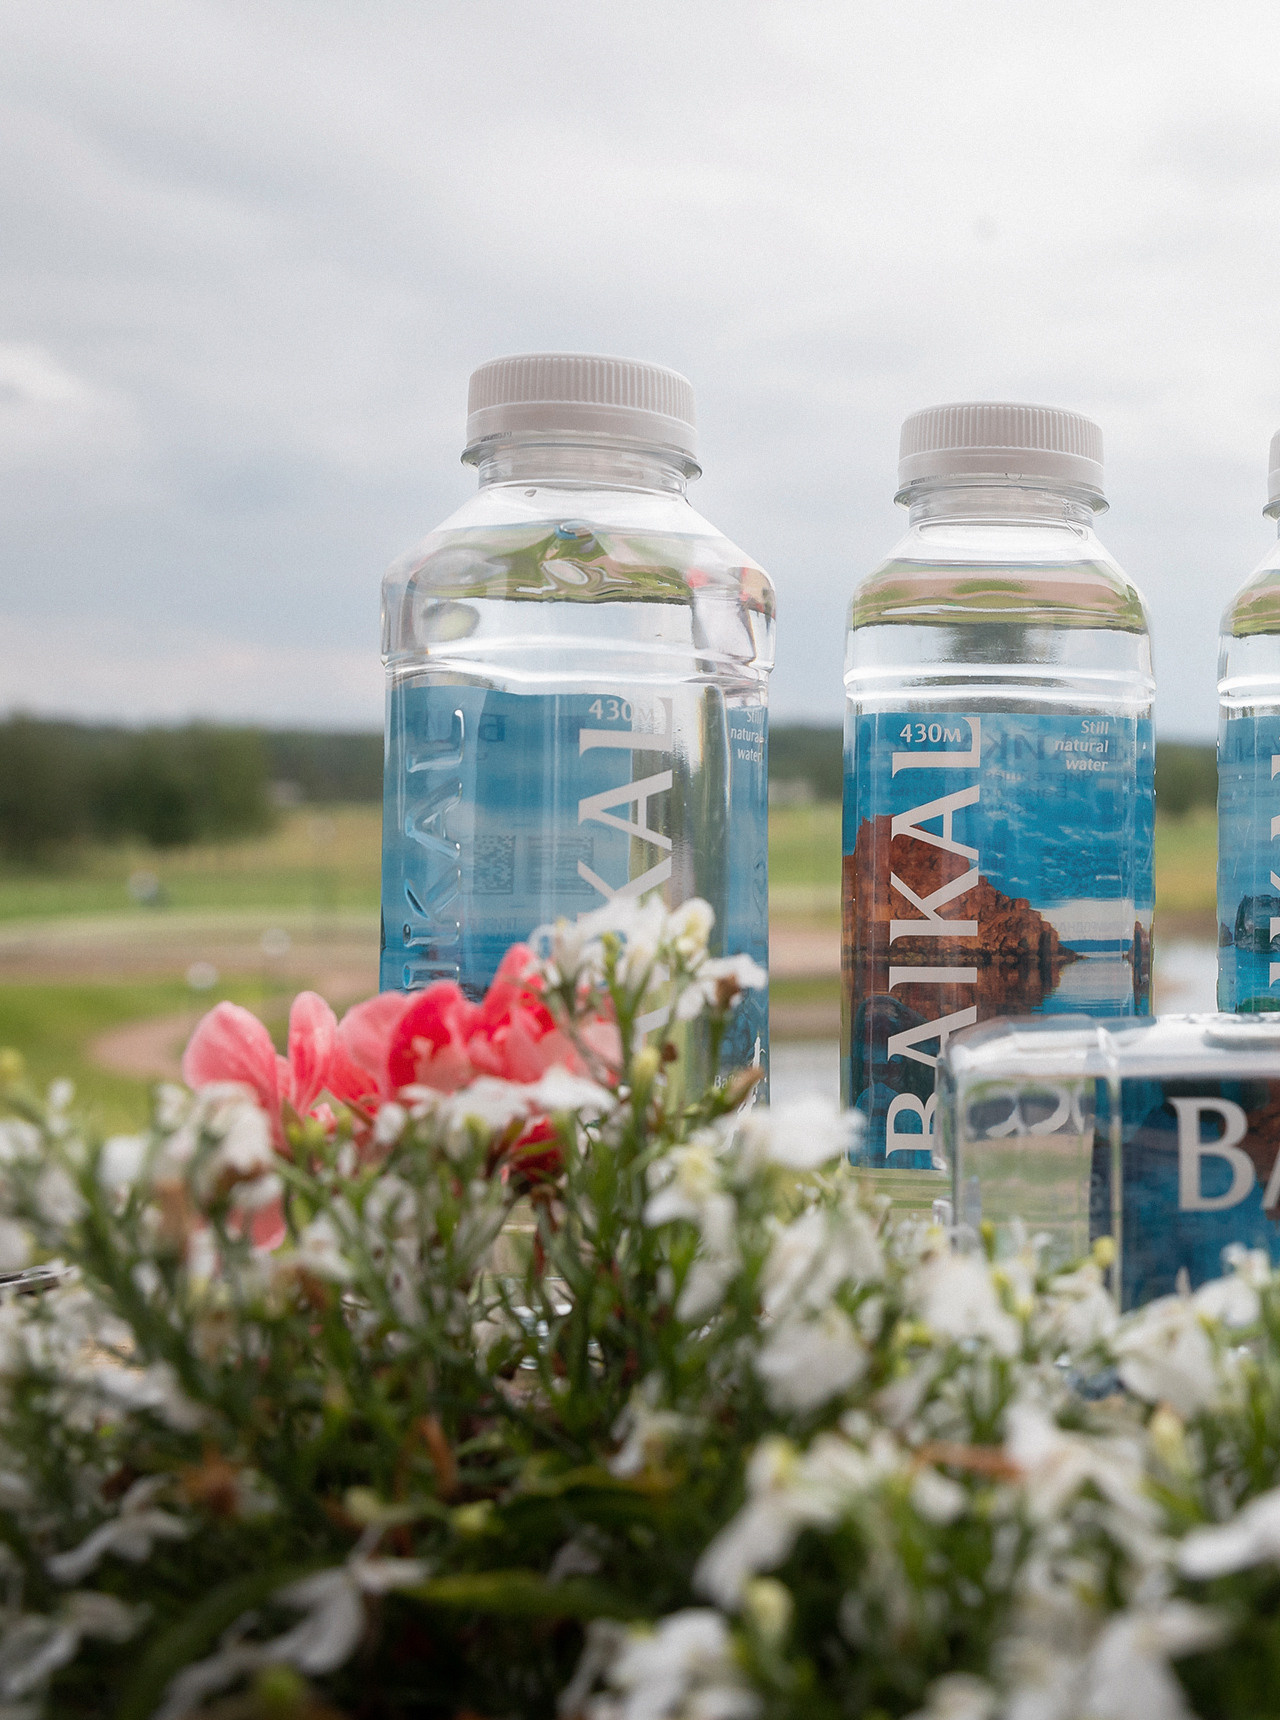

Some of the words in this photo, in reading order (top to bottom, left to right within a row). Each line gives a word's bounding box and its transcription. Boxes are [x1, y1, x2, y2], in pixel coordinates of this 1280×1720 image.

[1080, 719, 1109, 735] Still
[1054, 739, 1109, 753] natural
[1065, 758, 1109, 772] water
